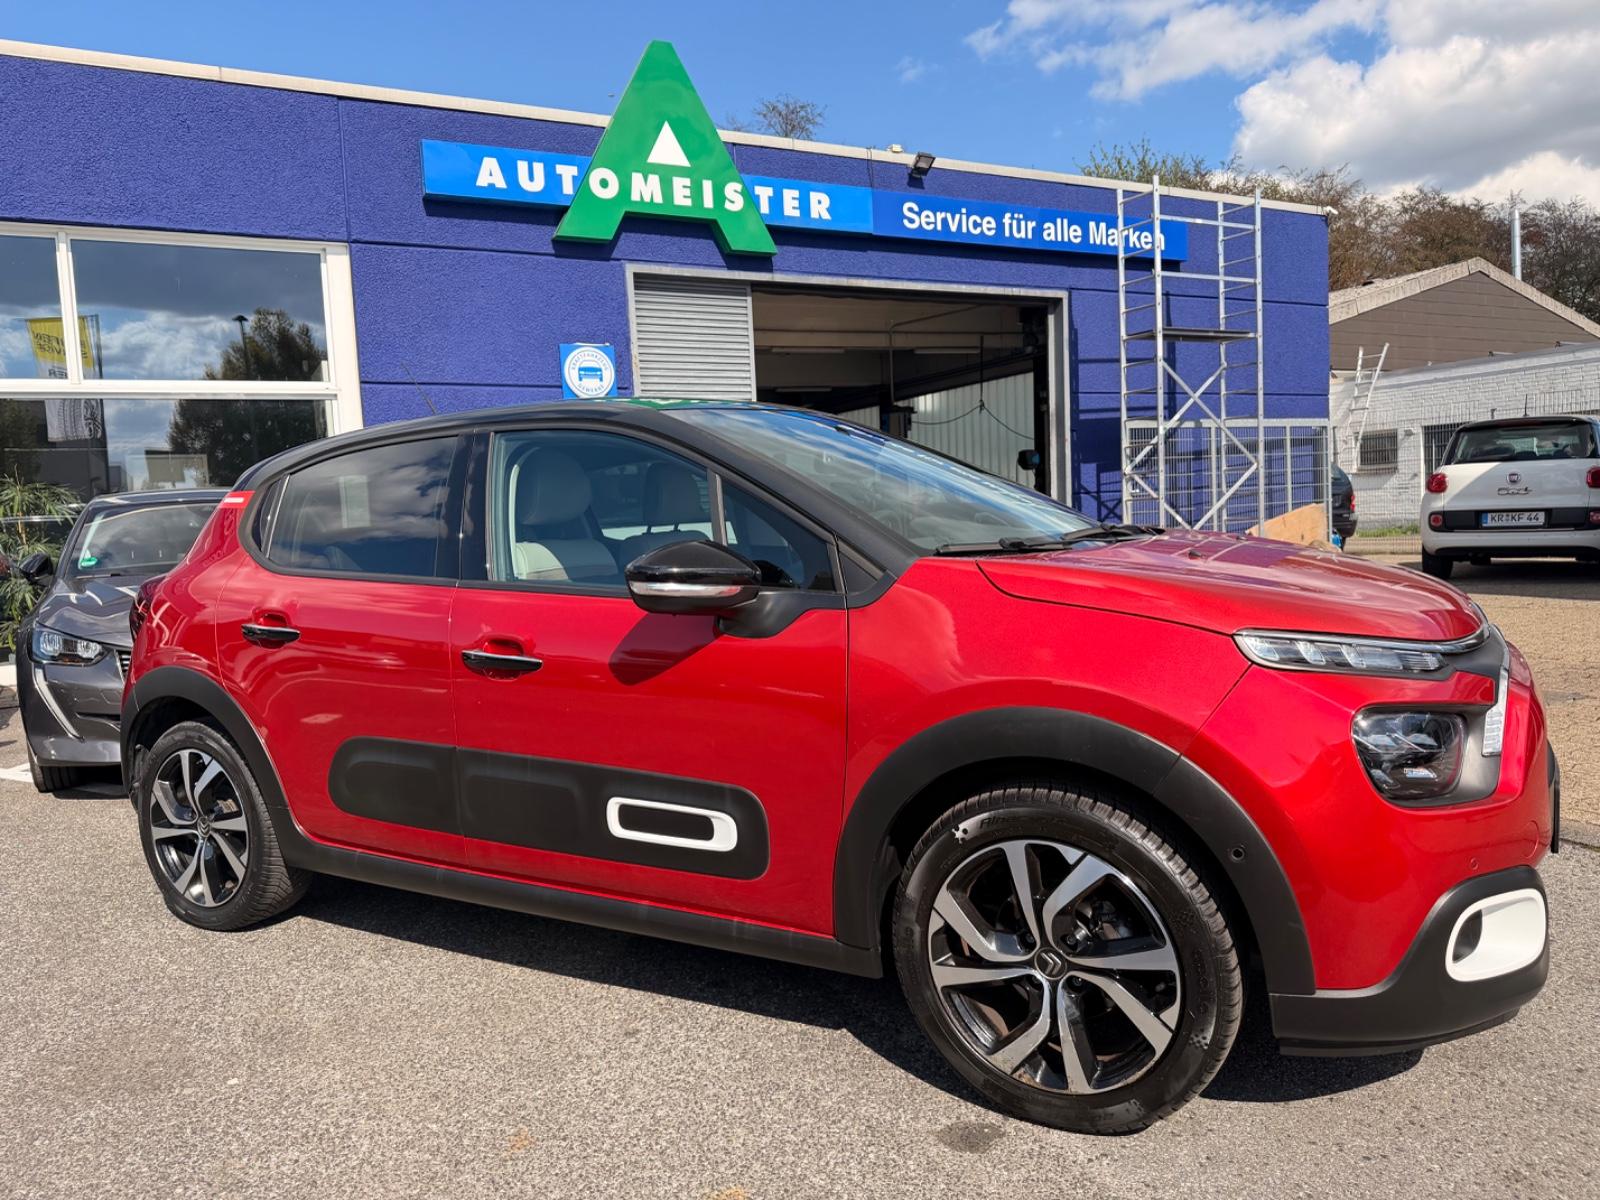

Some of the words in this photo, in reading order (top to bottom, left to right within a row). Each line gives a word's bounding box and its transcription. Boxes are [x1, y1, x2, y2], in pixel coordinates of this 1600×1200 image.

[476, 156, 832, 220] AUTOMEISTER
[902, 201, 997, 237] Service
[1003, 212, 1036, 240] für
[1042, 218, 1083, 244] alle
[1526, 512, 1539, 522] 44
